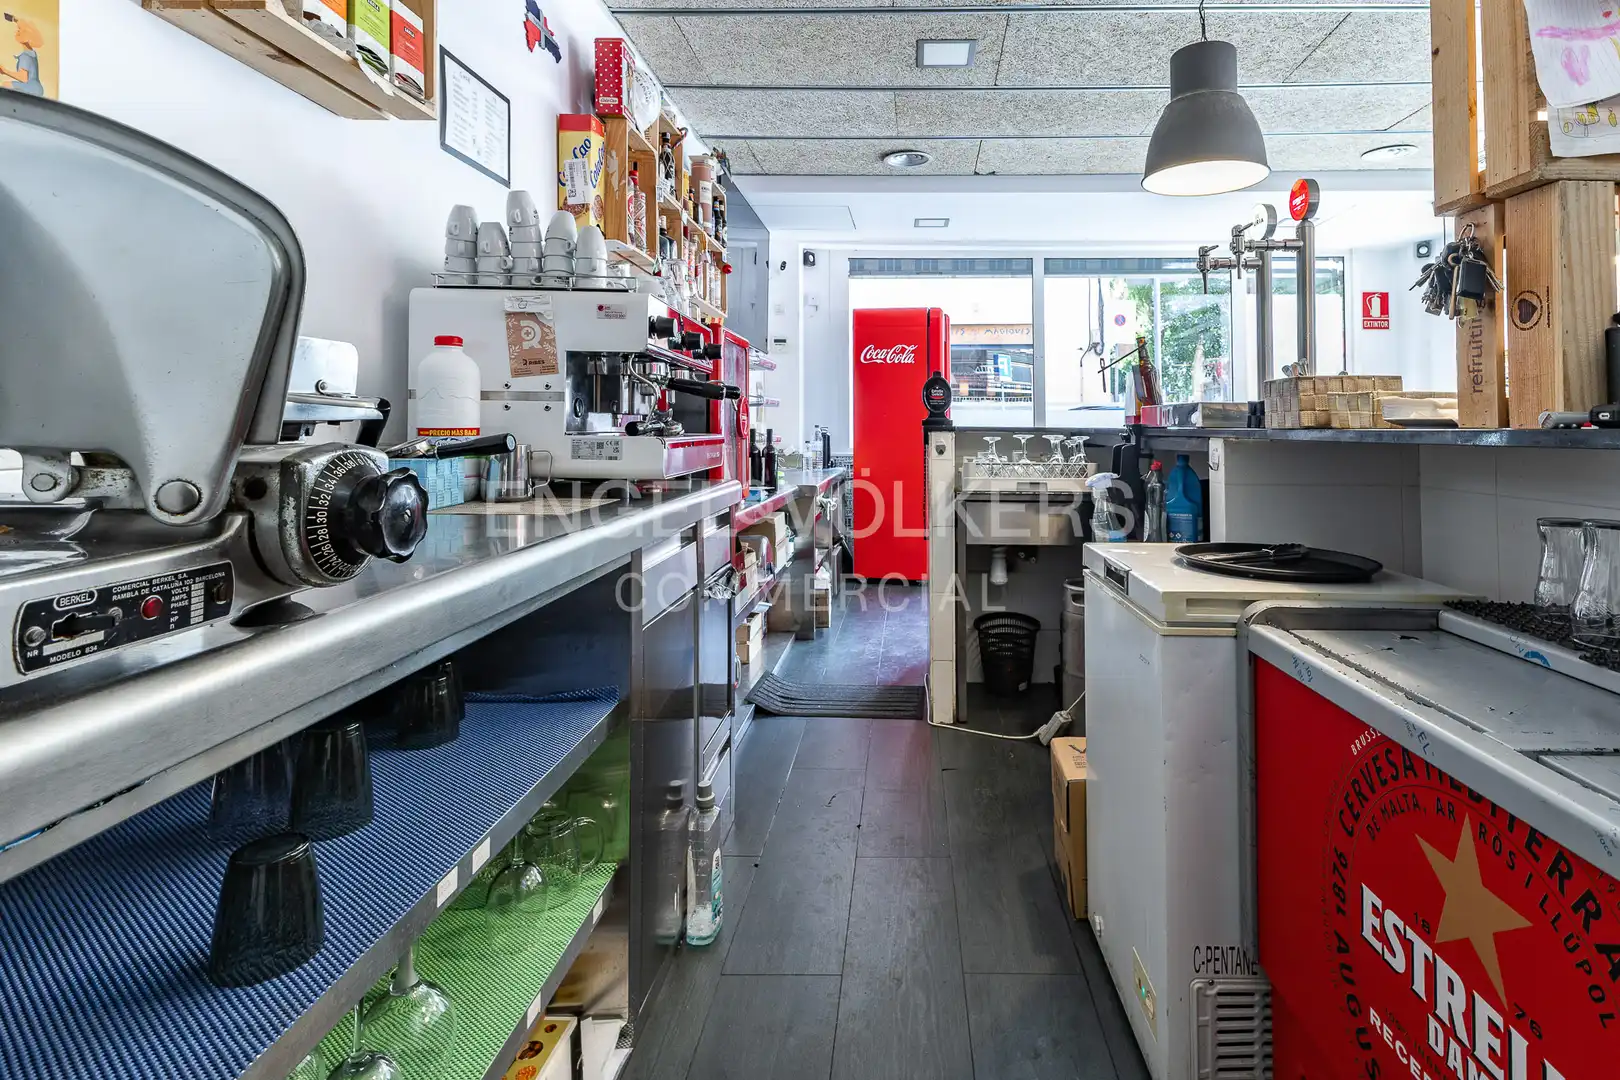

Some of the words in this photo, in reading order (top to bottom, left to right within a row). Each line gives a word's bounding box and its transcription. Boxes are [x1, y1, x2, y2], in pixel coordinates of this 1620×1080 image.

[1363, 320, 1389, 328] EXTINTOR
[860, 344, 918, 364] Coca-Cola
[344, 458, 356, 470] 38
[333, 466, 347, 478] 36
[324, 479, 338, 491] 34
[318, 493, 332, 507] 32
[316, 510, 328, 524] 30
[317, 528, 329, 541] 28
[321, 543, 334, 556] 26
[328, 555, 342, 567] 24
[112, 581, 150, 594] COMERCIAL
[152, 575, 176, 585] BERKEL
[112, 590, 139, 602] RAMBLA
[140, 587, 150, 595] DE
[151, 579, 183, 593] CATALUÑA
[195, 571, 226, 583] BARCELONA
[171, 586, 190, 595] VOLTS
[59, 592, 92, 607] BERKEL
[170, 599, 190, 609] PHASE
[170, 615, 179, 623] HP
[26, 649, 39, 659] NR
[49, 649, 82, 664] MODELO
[84, 645, 98, 654] 834
[1338, 746, 1418, 838] CERVESA
[1365, 814, 1381, 841] DE
[1524, 871, 1533, 889] I
[1332, 846, 1349, 918] 1876
[1413, 911, 1432, 935] 18
[1193, 945, 1259, 976] C-PENTANE
